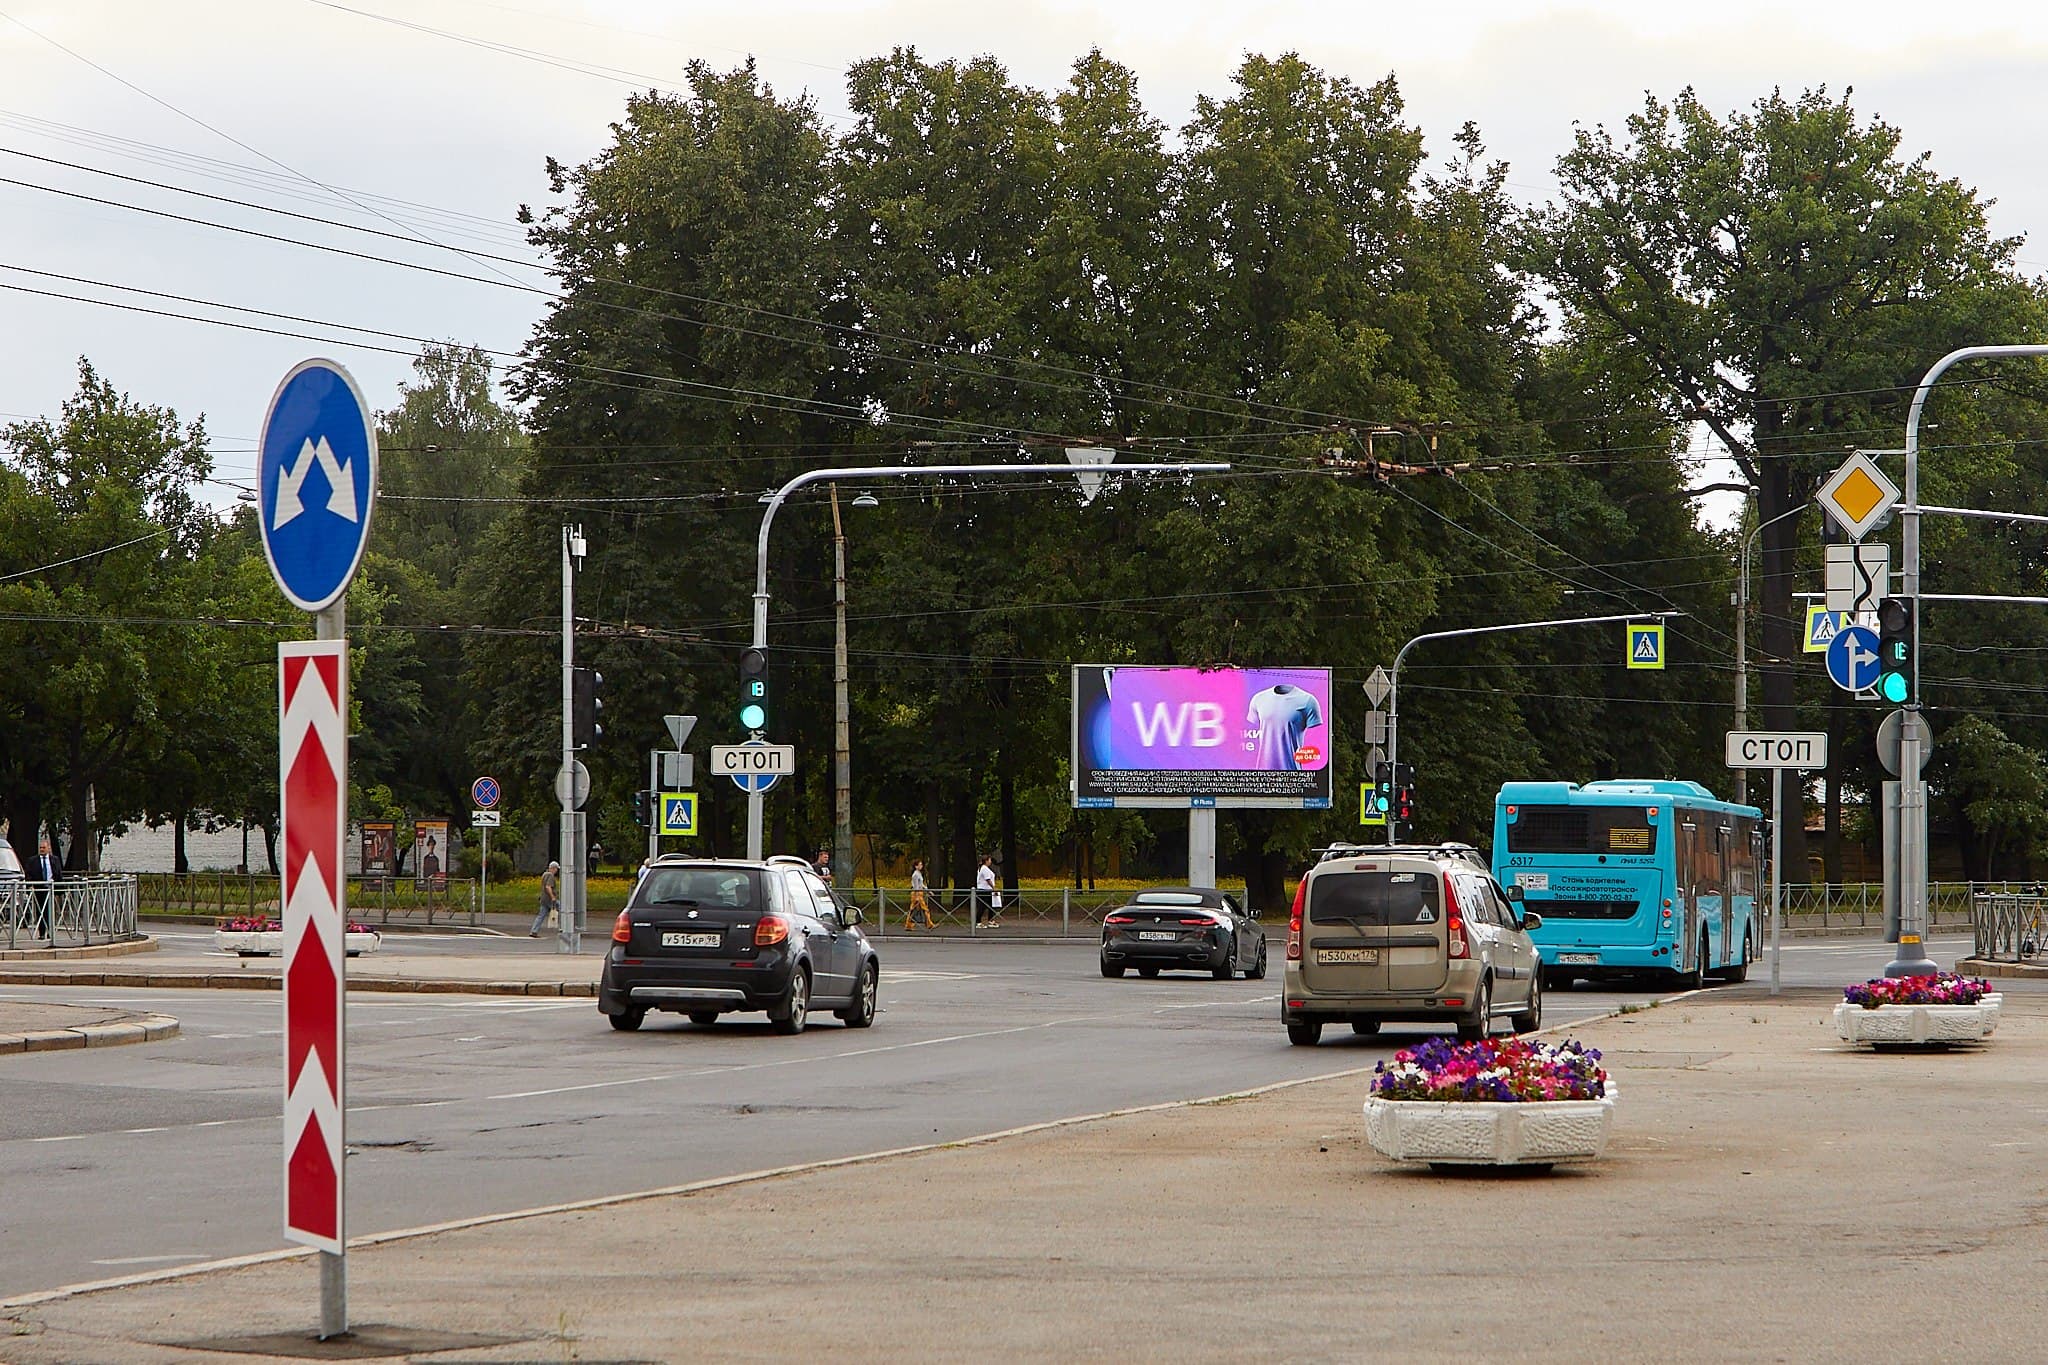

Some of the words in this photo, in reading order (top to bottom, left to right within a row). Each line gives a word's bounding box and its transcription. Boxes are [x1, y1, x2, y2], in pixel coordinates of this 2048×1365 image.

[1131, 701, 1226, 747] WB
[1742, 738, 1811, 761] СТОП
[724, 751, 781, 769] СТОП
[1510, 856, 1534, 866] 6317
[1586, 877, 1626, 885] водителем
[1420, 911, 1430, 919] Ш
[666, 935, 704, 944] У515КР
[707, 935, 717, 943] 98
[1320, 950, 1359, 961] Н530КМ
